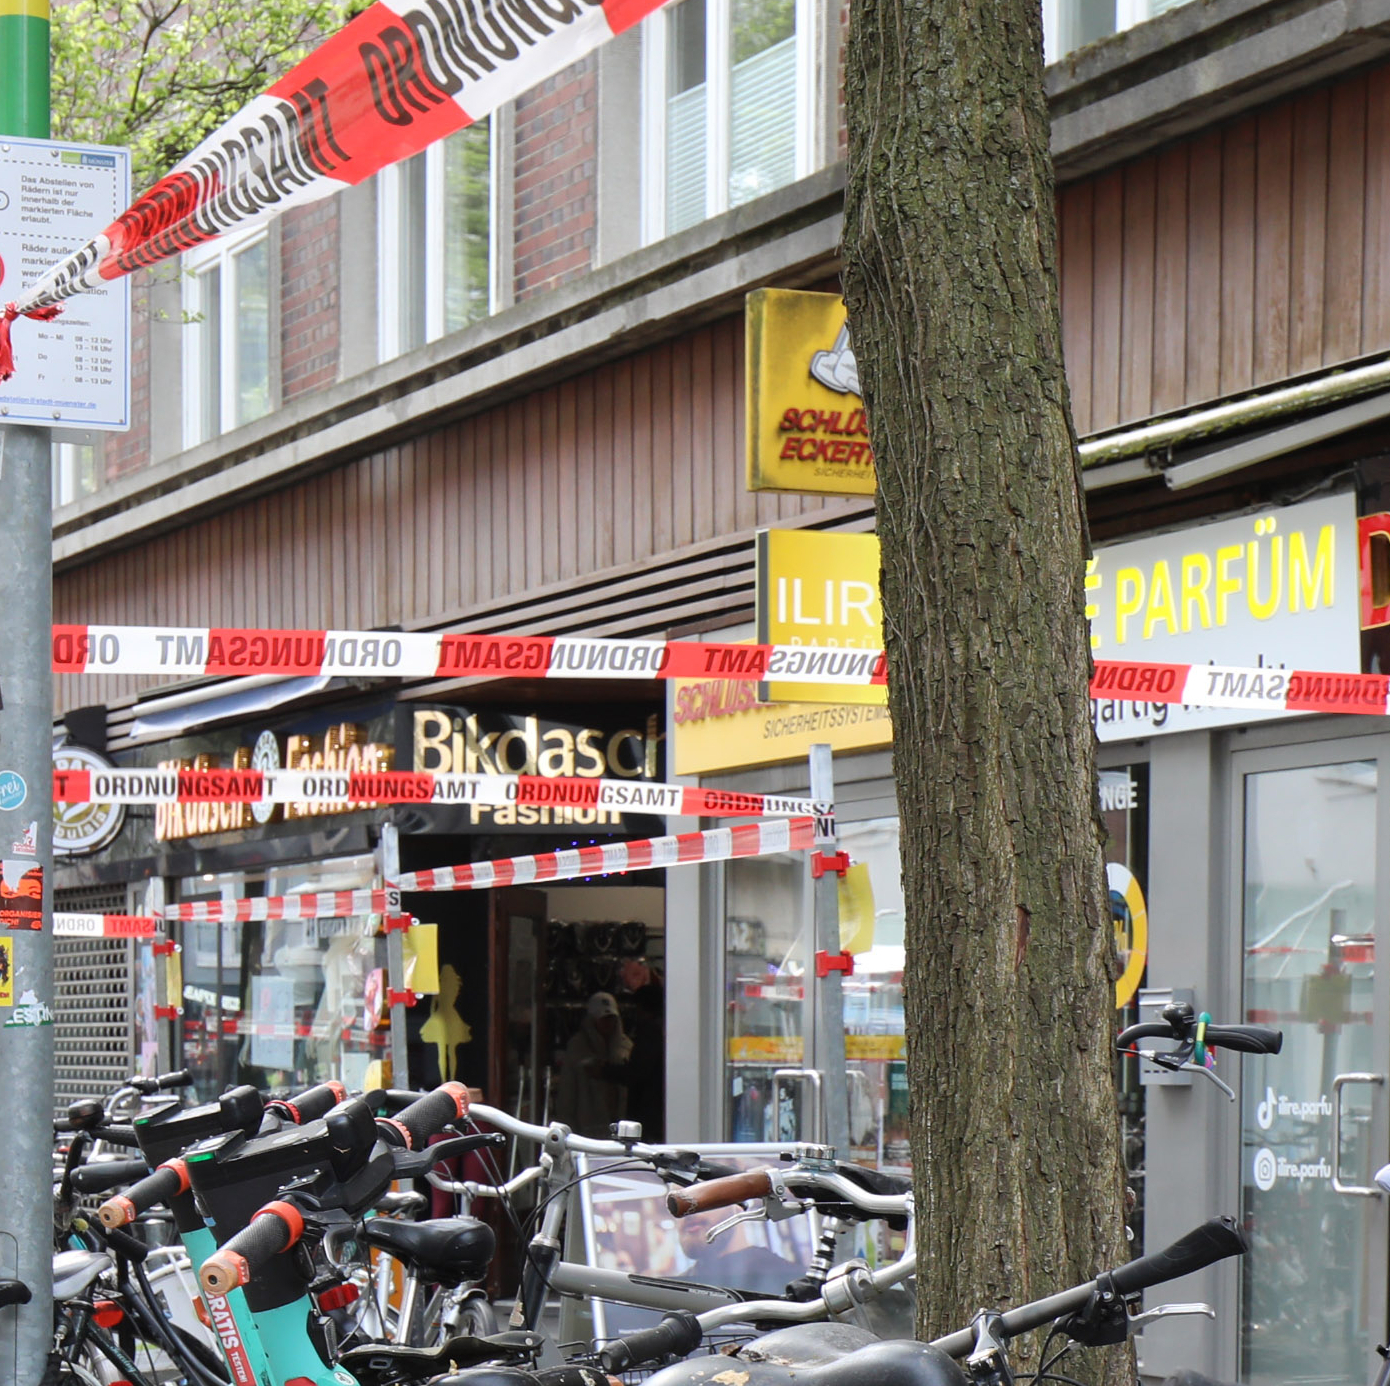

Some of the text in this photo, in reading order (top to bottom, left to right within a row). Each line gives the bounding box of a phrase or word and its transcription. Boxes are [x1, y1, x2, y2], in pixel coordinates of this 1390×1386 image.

[21, 175, 95, 189] Das Abstellen von
[21, 185, 79, 198] Rädern ist nur
[21, 195, 75, 207] innerhalb der
[21, 205, 94, 219] markierten Fläche
[21, 215, 52, 225] erlaubt.
[21, 243, 48, 254] Räder
[1115, 516, 1336, 645] PARFÜM
[95, 775, 278, 799] ORDNUNGSAMT
[302, 775, 481, 802] ORDNUNGSAMT
[505, 781, 680, 808] ORDNUNGSAMT
[1277, 1094, 1333, 1120] ilire.parfu
[1276, 1157, 1332, 1183] ilire.parfu
